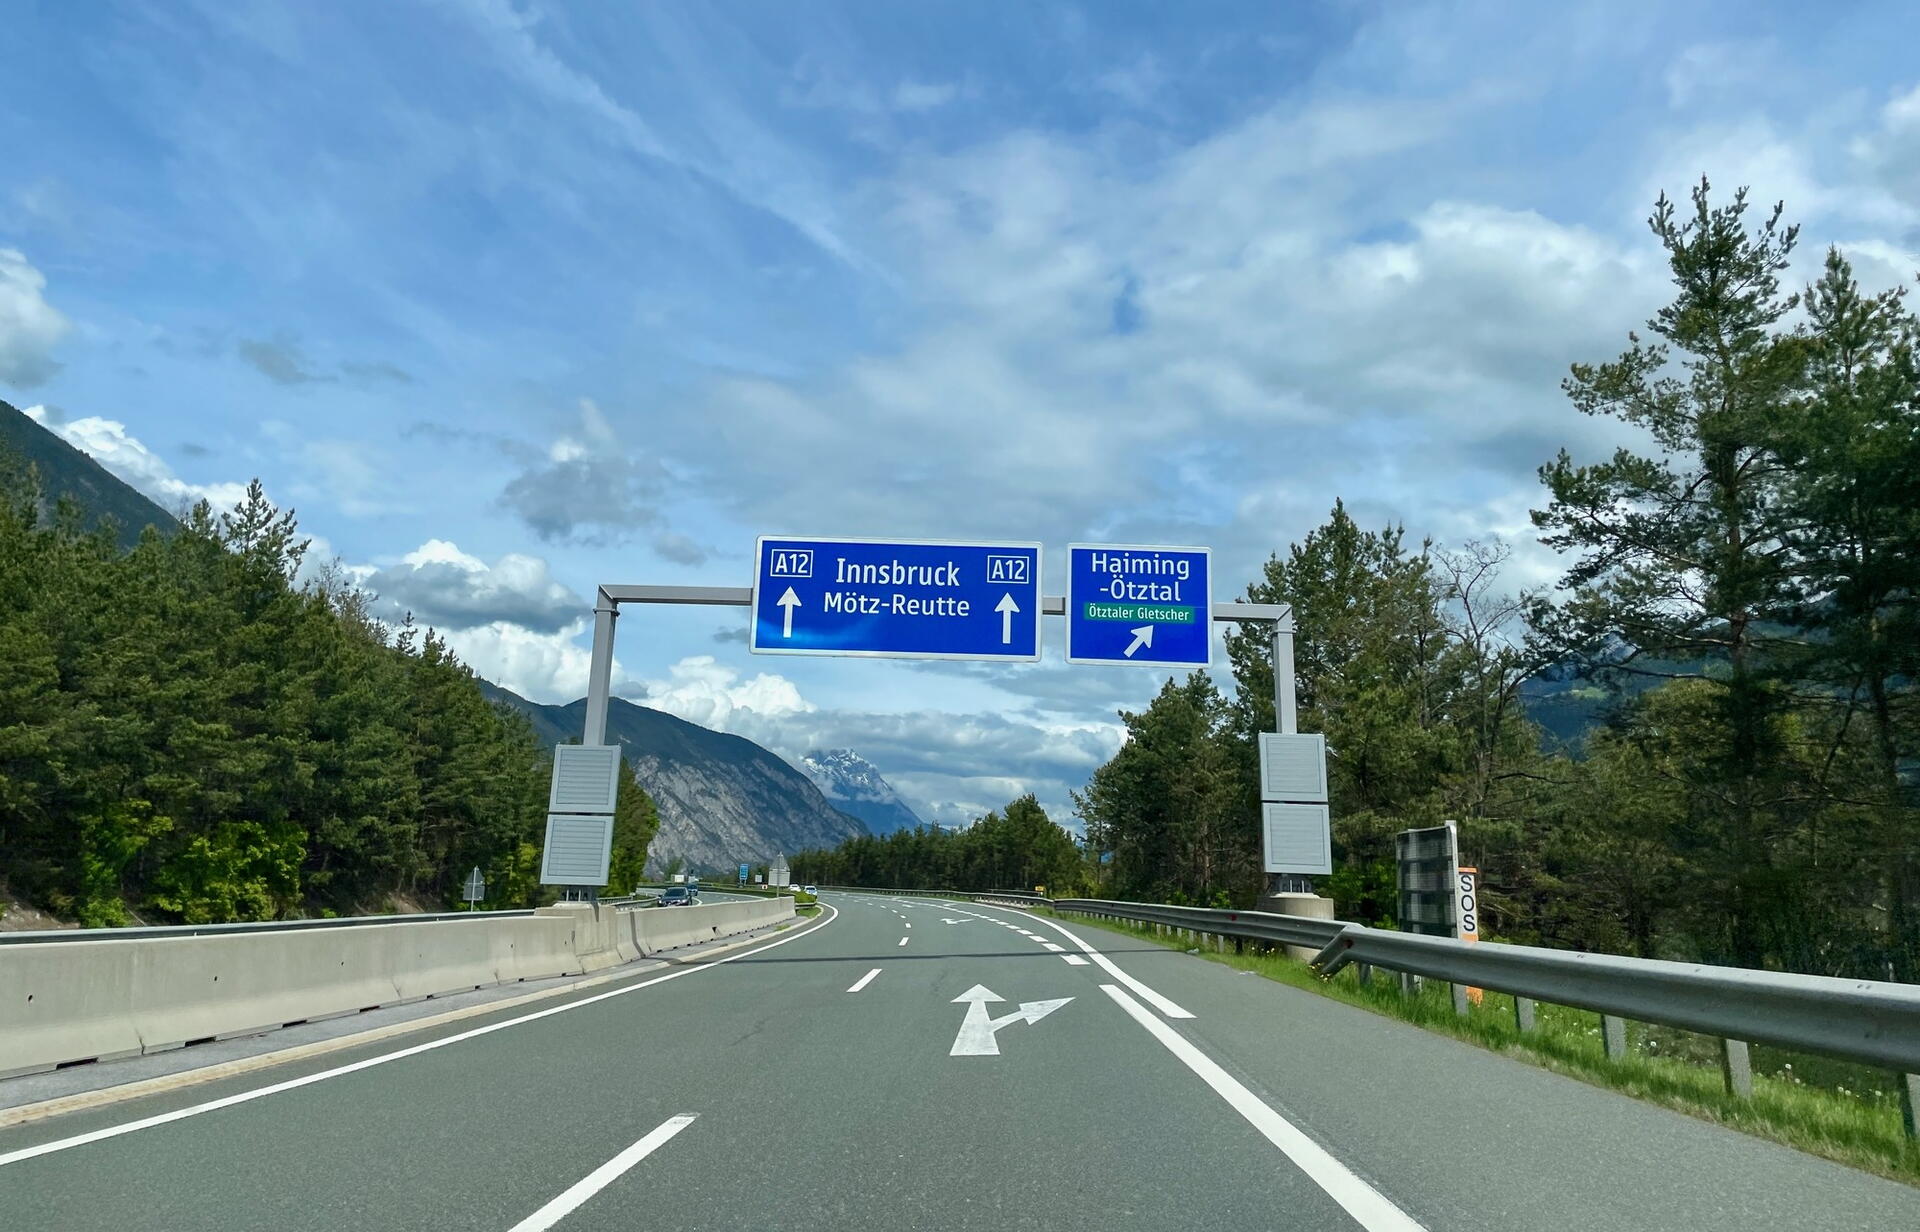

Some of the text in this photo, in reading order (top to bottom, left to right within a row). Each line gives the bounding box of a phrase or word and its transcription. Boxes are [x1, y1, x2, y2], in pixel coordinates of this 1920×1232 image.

[775, 553, 809, 574] A12
[836, 558, 960, 587] Innsbruck
[991, 560, 1025, 580] A12
[1091, 552, 1190, 581] Haiming
[1100, 574, 1181, 601] -Ötztal
[823, 592, 970, 616] Mötz-Reutte
[1089, 603, 1190, 621] Ötztaler Gletscher
[1461, 874, 1475, 932] SOS
